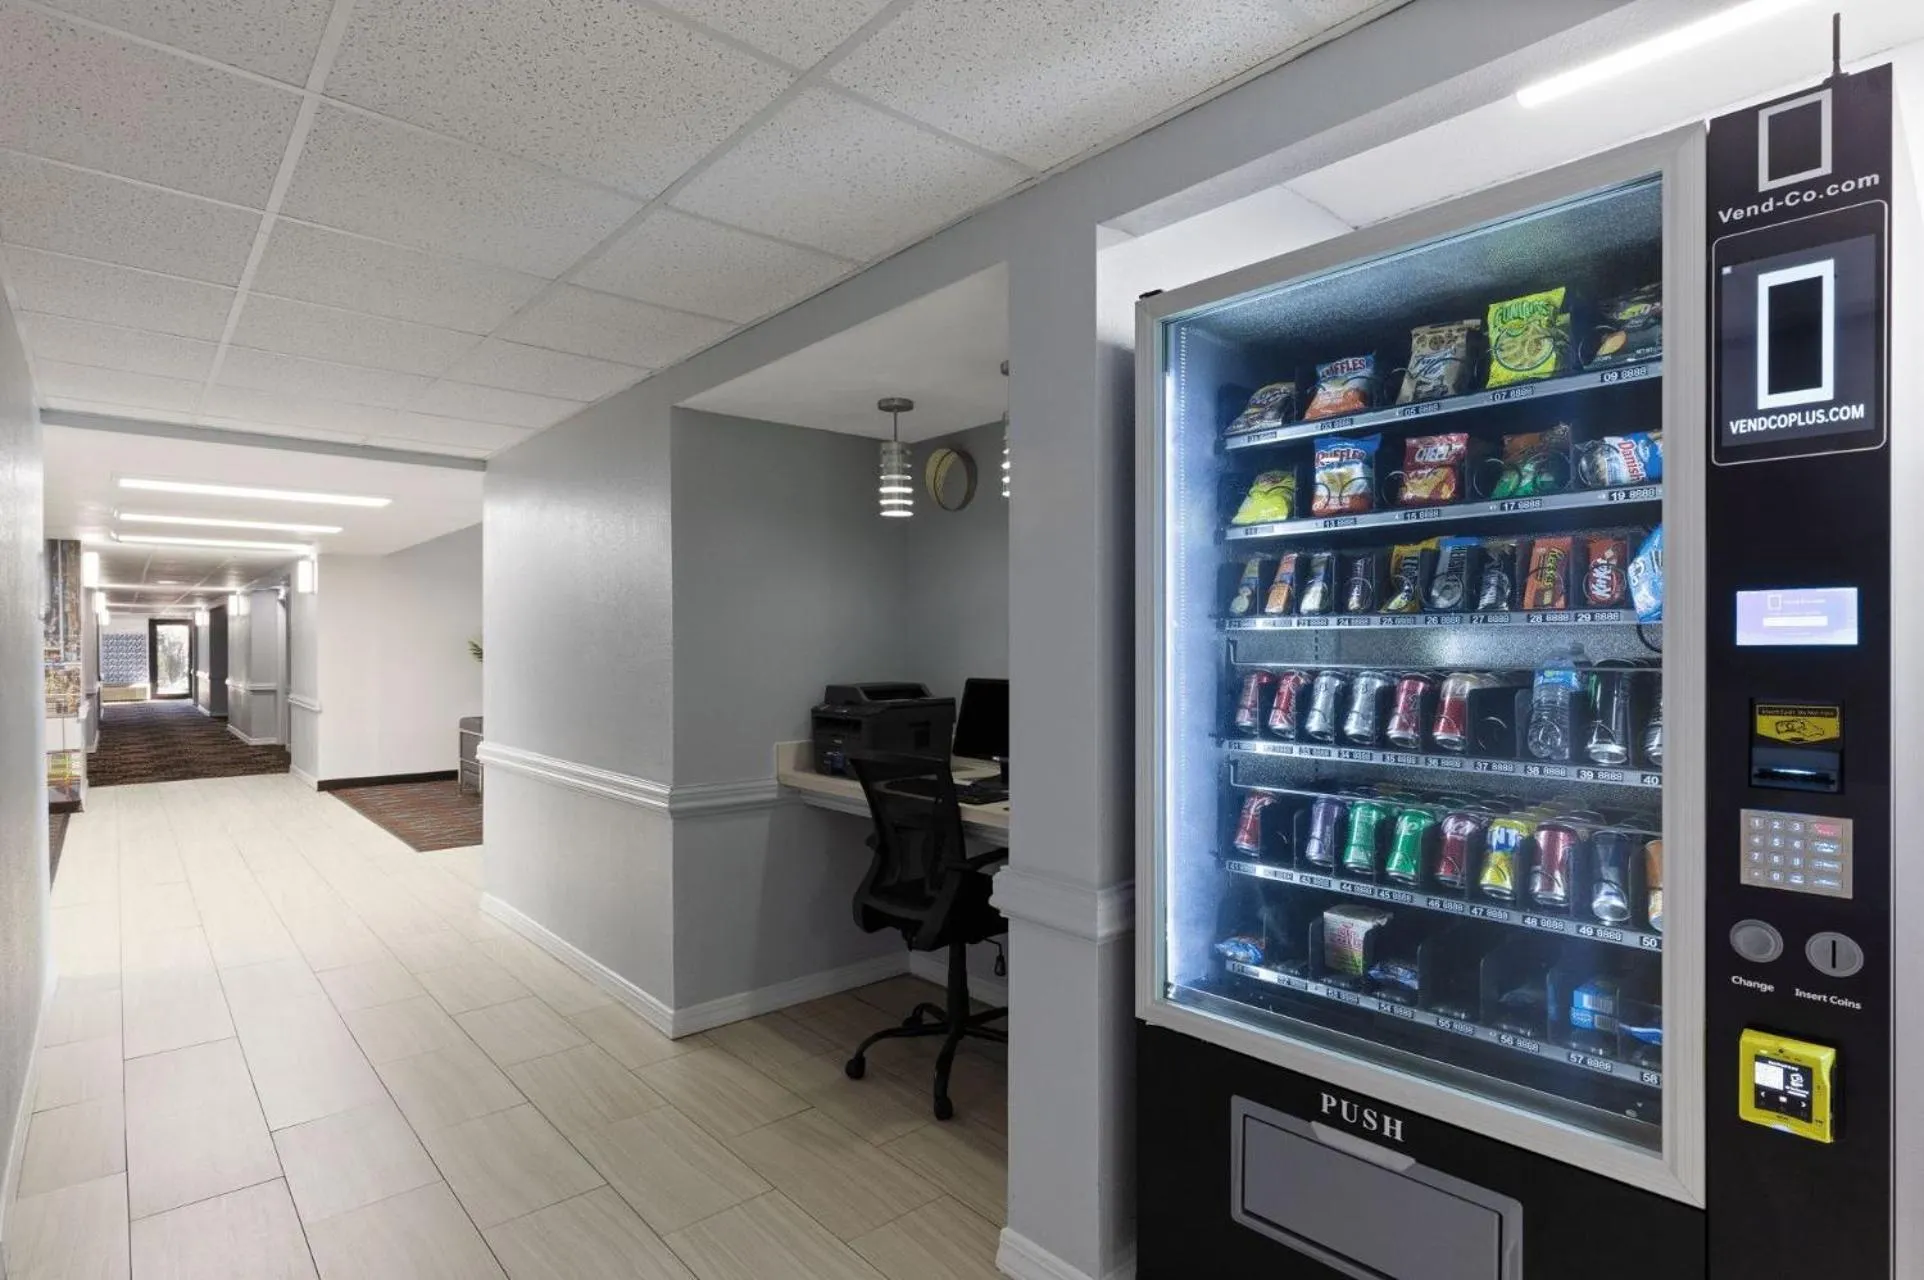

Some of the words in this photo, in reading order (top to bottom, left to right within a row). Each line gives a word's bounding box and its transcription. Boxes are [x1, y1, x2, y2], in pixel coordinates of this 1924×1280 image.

[1717, 173, 1880, 223] Vend-Co.com
[1603, 372, 1618, 382] 09
[1494, 392, 1507, 402] 07
[1729, 403, 1865, 435] VENDCOPLUS.COM
[1617, 439, 1646, 483] Danish
[1611, 491, 1626, 501] 19
[1501, 503, 1515, 511] 17
[1427, 616, 1439, 625] 26
[1472, 615, 1485, 624] 27
[1529, 614, 1543, 623] 28
[1577, 613, 1592, 622] 29
[1475, 761, 1488, 770] 37
[1526, 765, 1540, 775] 38
[1579, 770, 1594, 780] 39
[1643, 775, 1660, 785] 40
[1470, 906, 1483, 916] 47
[1524, 916, 1537, 926] 48
[1579, 926, 1593, 936] 49
[1642, 937, 1658, 947] 50
[1731, 975, 1775, 993] Change
[1795, 988, 1828, 1003] Insert
[1829, 995, 1862, 1010] Coins
[1569, 1053, 1584, 1063] 57
[1642, 1073, 1658, 1084] 58
[1320, 1092, 1405, 1142] PUSH
